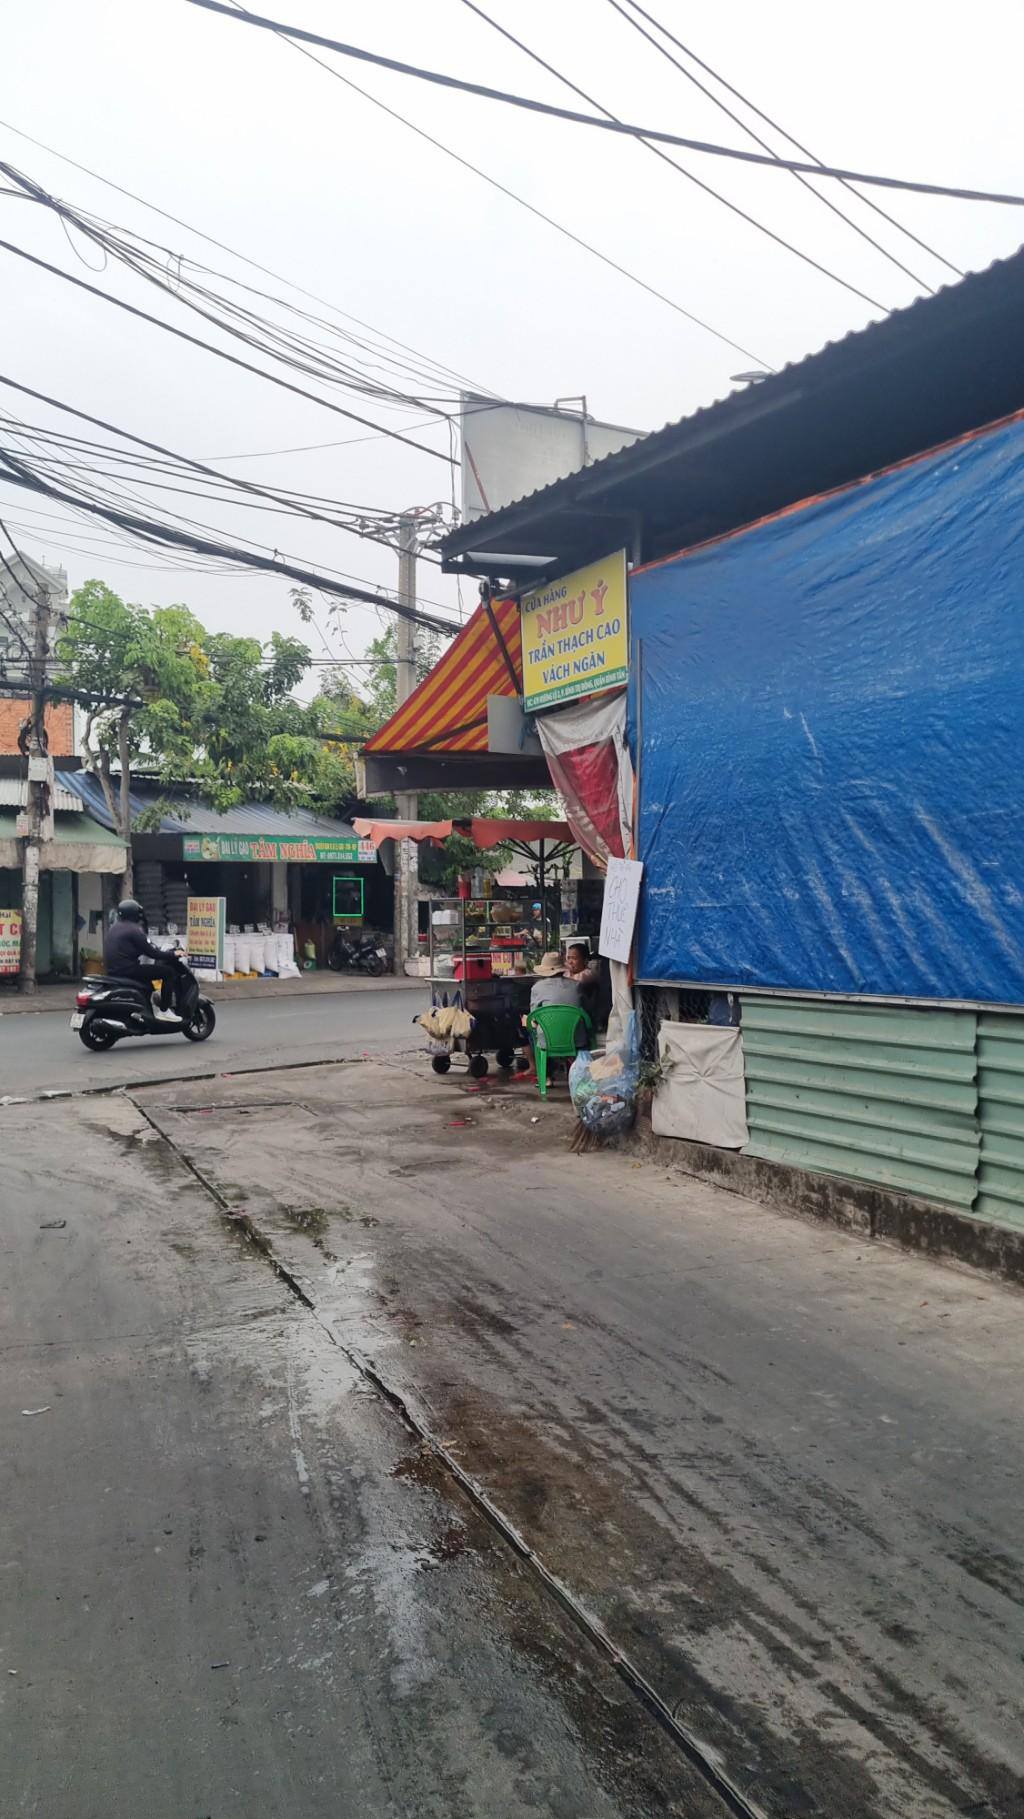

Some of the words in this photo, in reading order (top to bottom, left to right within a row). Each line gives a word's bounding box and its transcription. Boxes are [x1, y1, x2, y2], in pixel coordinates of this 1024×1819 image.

[525, 592, 542, 612] CỬA
[543, 585, 567, 605] HÀNG
[536, 590, 586, 638] NHƯ
[591, 579, 608, 616] Ý
[528, 640, 555, 664] TRẦN
[557, 628, 594, 654] THẠCH
[596, 618, 621, 640] CAO
[542, 663, 570, 684] VÁCH
[573, 651, 605, 675] NGĂN
[249, 836, 277, 859] TÂM
[279, 837, 317, 859] NGHĨA
